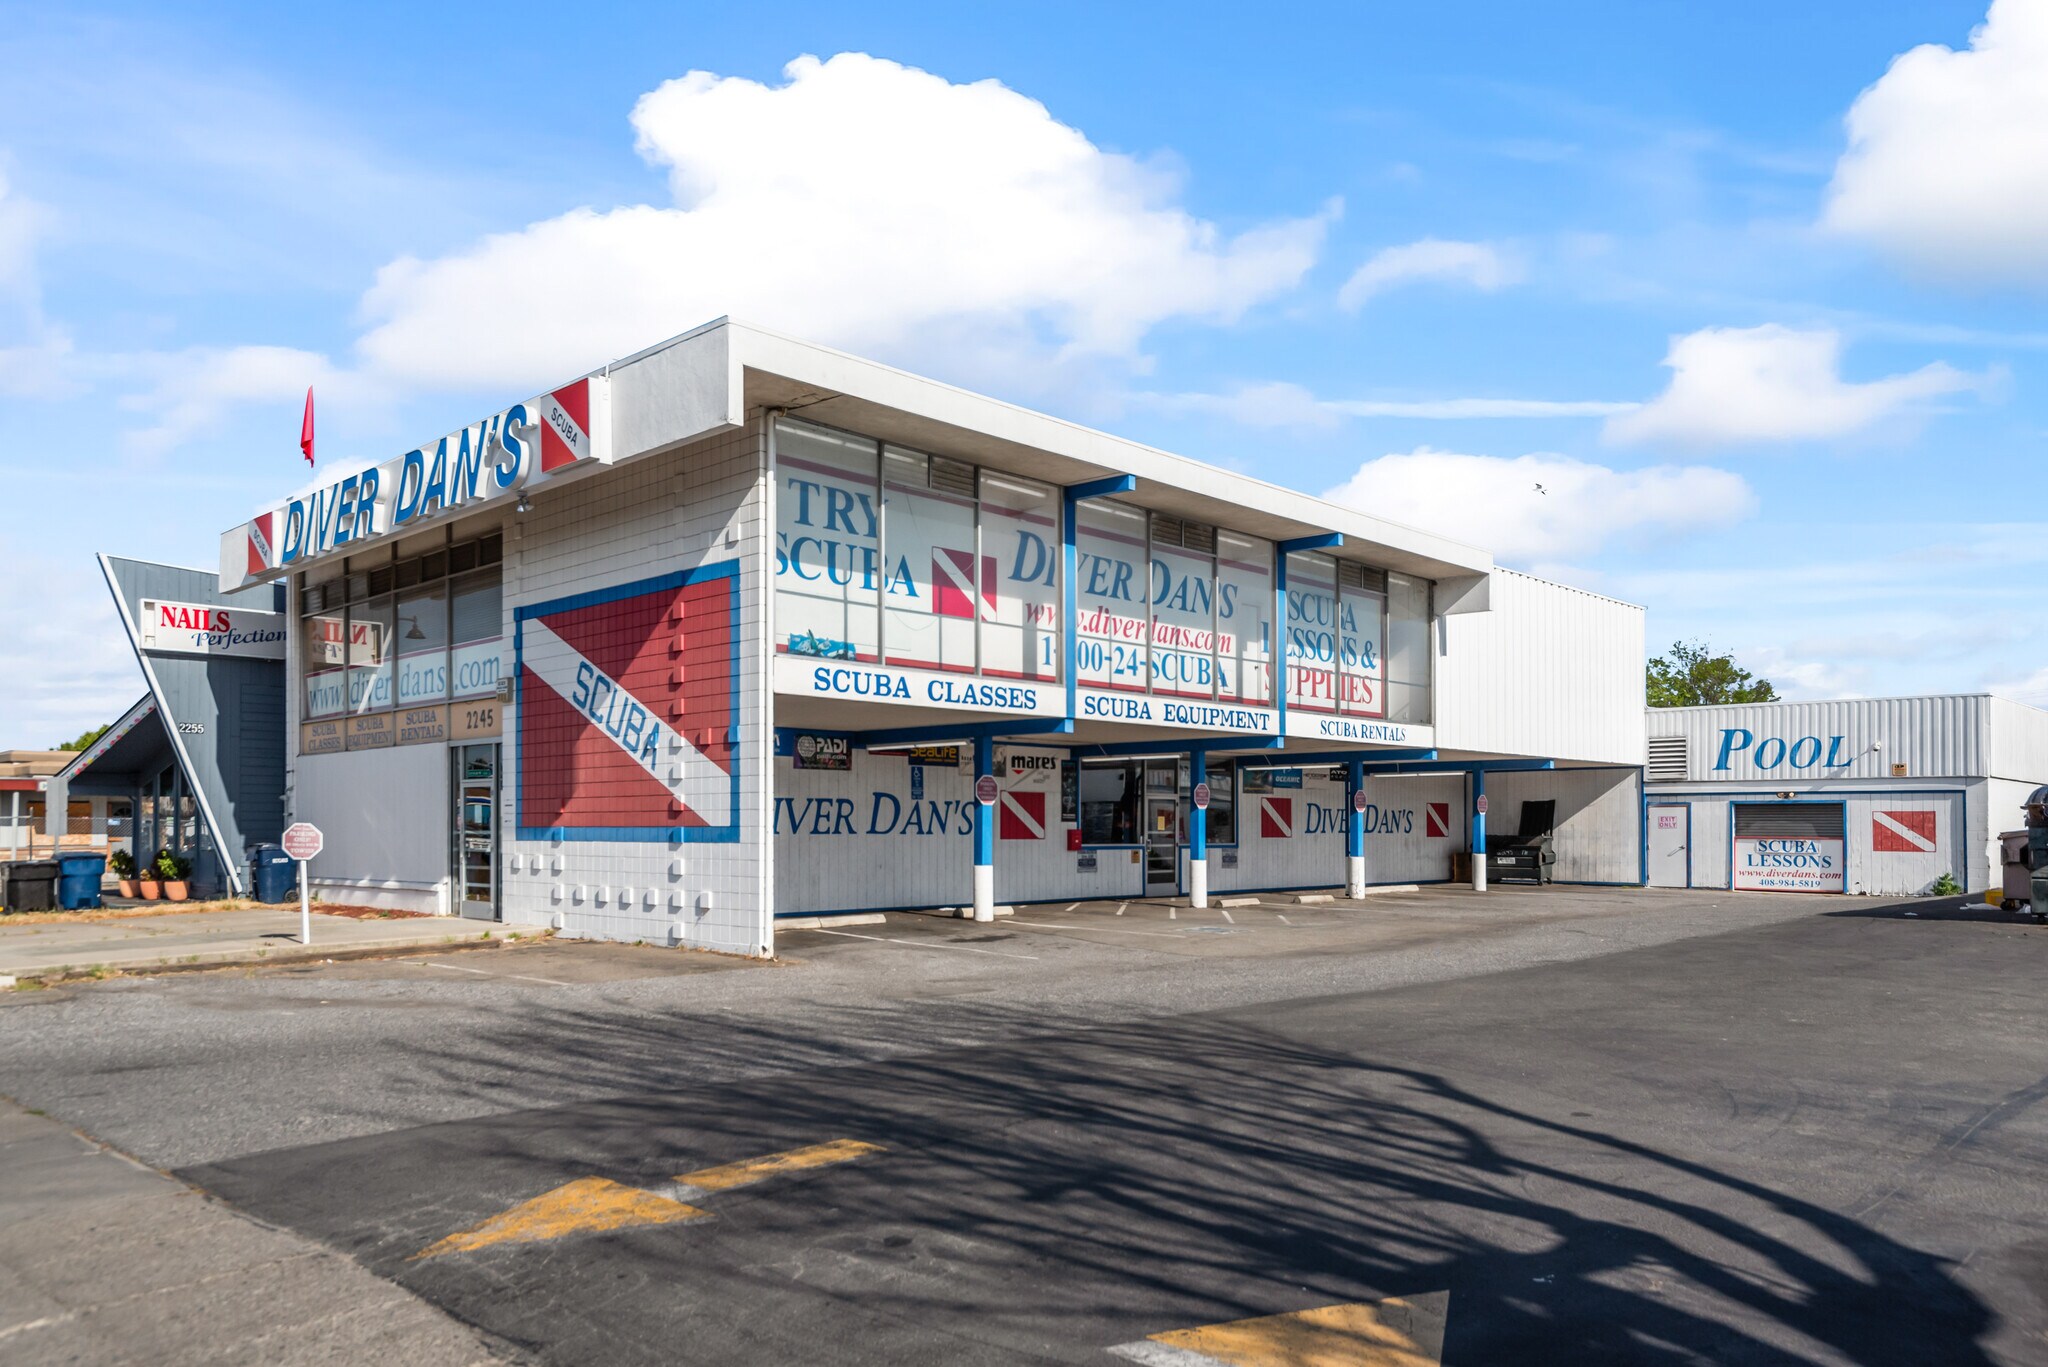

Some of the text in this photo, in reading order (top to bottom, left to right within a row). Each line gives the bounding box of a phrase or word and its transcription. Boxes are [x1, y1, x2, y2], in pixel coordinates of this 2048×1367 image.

[550, 407, 578, 447] SCUBA
[281, 404, 528, 564] DIVER DAN'S
[787, 477, 889, 539] TRY
[1007, 529, 1133, 603] DIER
[160, 605, 231, 633] NAILS
[1287, 589, 1358, 633] SCUBA
[191, 627, 287, 650] Perfection
[1360, 639, 1377, 670] &
[813, 666, 1037, 710] SCUBA CLASSES
[356, 717, 384, 731] SCUBA
[406, 710, 437, 725] SCUBA
[466, 708, 494, 730] 2245
[572, 660, 660, 772] SCUBA
[1084, 695, 1271, 731] SCUBA EQUIPMENT
[179, 722, 205, 735] 2255
[311, 723, 337, 737] SCUBA
[349, 730, 393, 748] EQUIPMENT
[401, 724, 444, 741] RENTALS
[1320, 719, 1407, 742] SCUBA RENTALS
[308, 736, 341, 751] CLASSES
[816, 738, 847, 754] PADI
[1711, 728, 1854, 771] POOL
[1011, 755, 1057, 770] mares
[1275, 775, 1301, 784] OCEANIC
[774, 791, 975, 836] IVER DAN'S
[1304, 803, 1414, 834] DIVE DAN'S
[1758, 840, 1818, 854] SCUBA
[1747, 853, 1832, 869] LESSONS
[1738, 868, 1842, 880] www.diverdans.com
[1758, 878, 1821, 888] 408-984-5819
